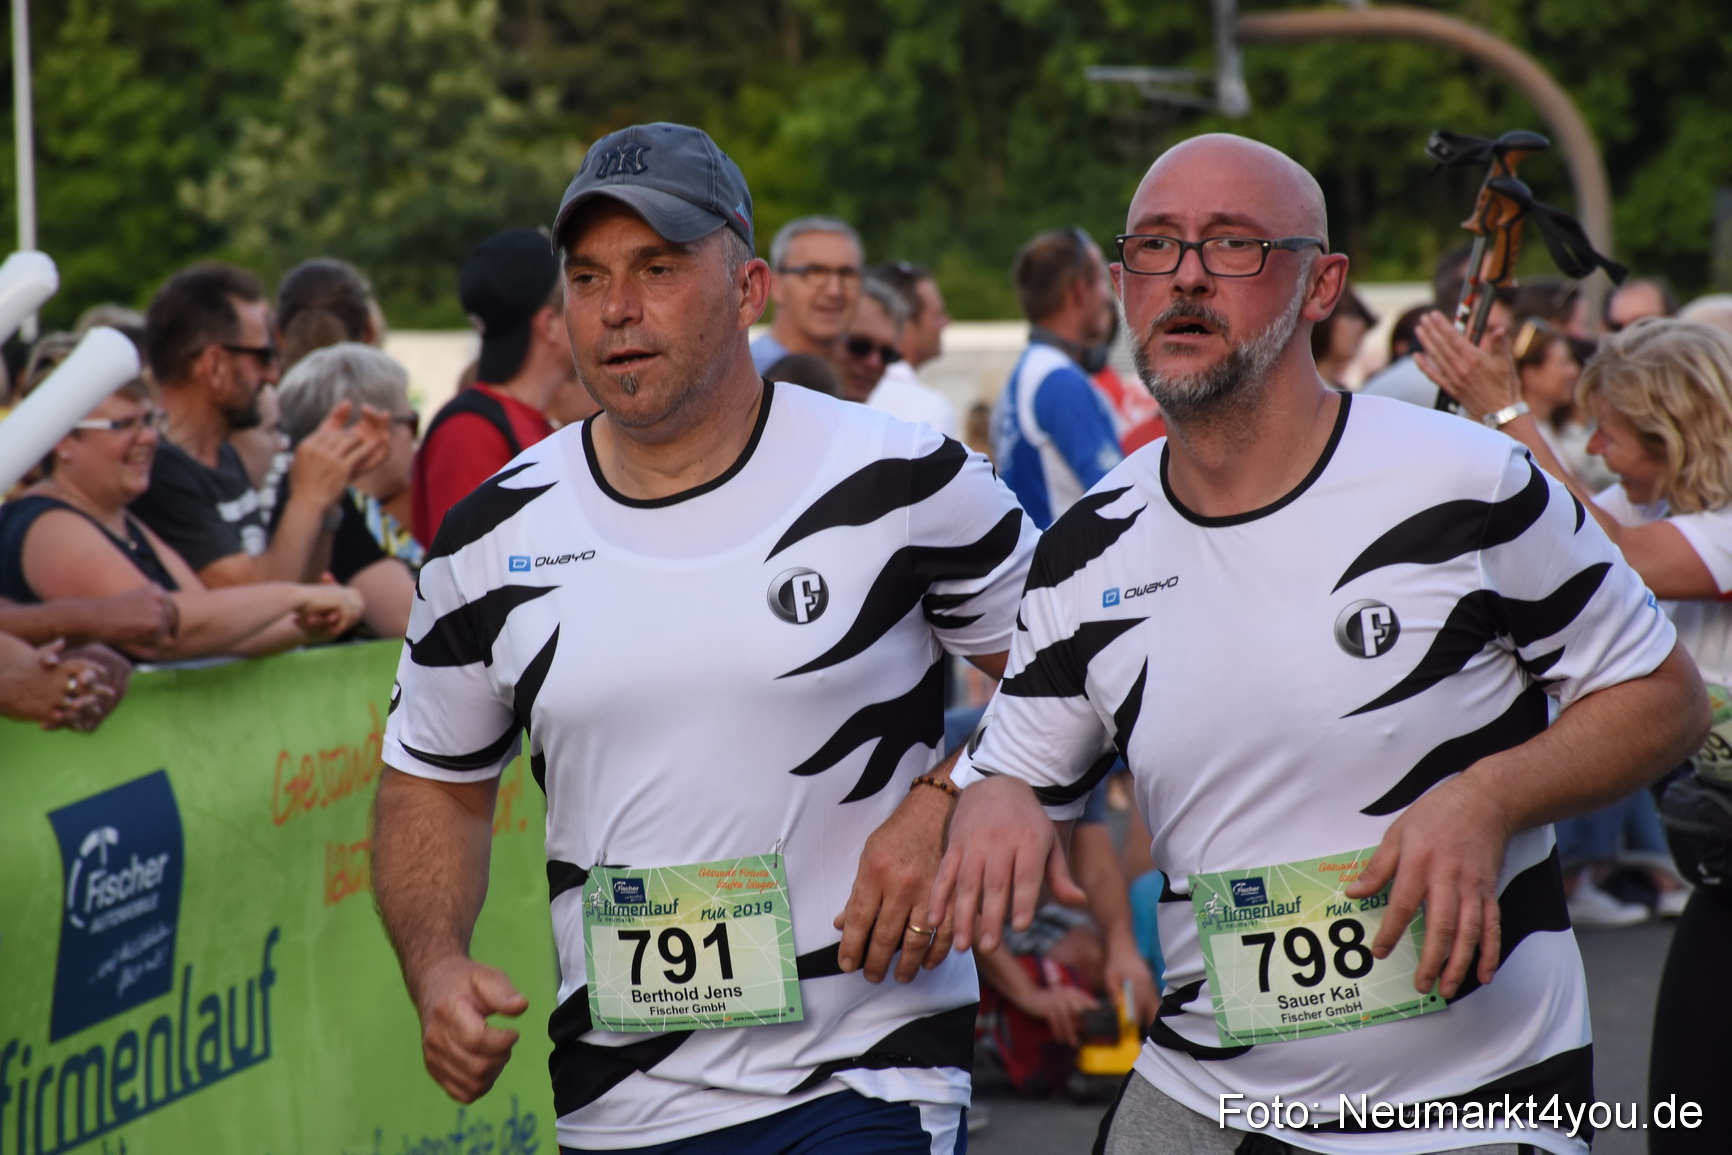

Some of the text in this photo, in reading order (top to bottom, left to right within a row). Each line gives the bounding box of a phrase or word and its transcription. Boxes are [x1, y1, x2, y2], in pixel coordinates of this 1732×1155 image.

[698, 866, 769, 878] Gesunde Firmen
[84, 852, 170, 915] Fischer
[716, 878, 744, 891] laufen
[603, 897, 680, 917] firmenlauf
[733, 900, 773, 919] 2019
[1223, 895, 1302, 922] firmenlauf
[1359, 893, 1390, 912] 201
[618, 922, 734, 986] 791
[1241, 917, 1375, 993] 798
[631, 985, 743, 1004] Berthold Jens
[1277, 983, 1361, 1010] Sauer Kai
[649, 1002, 727, 1016] Fischer GmbH
[1280, 1009, 1324, 1024] Fischer
[1325, 1002, 1364, 1020] GmbH
[0, 925, 281, 1155] firmenlauf
